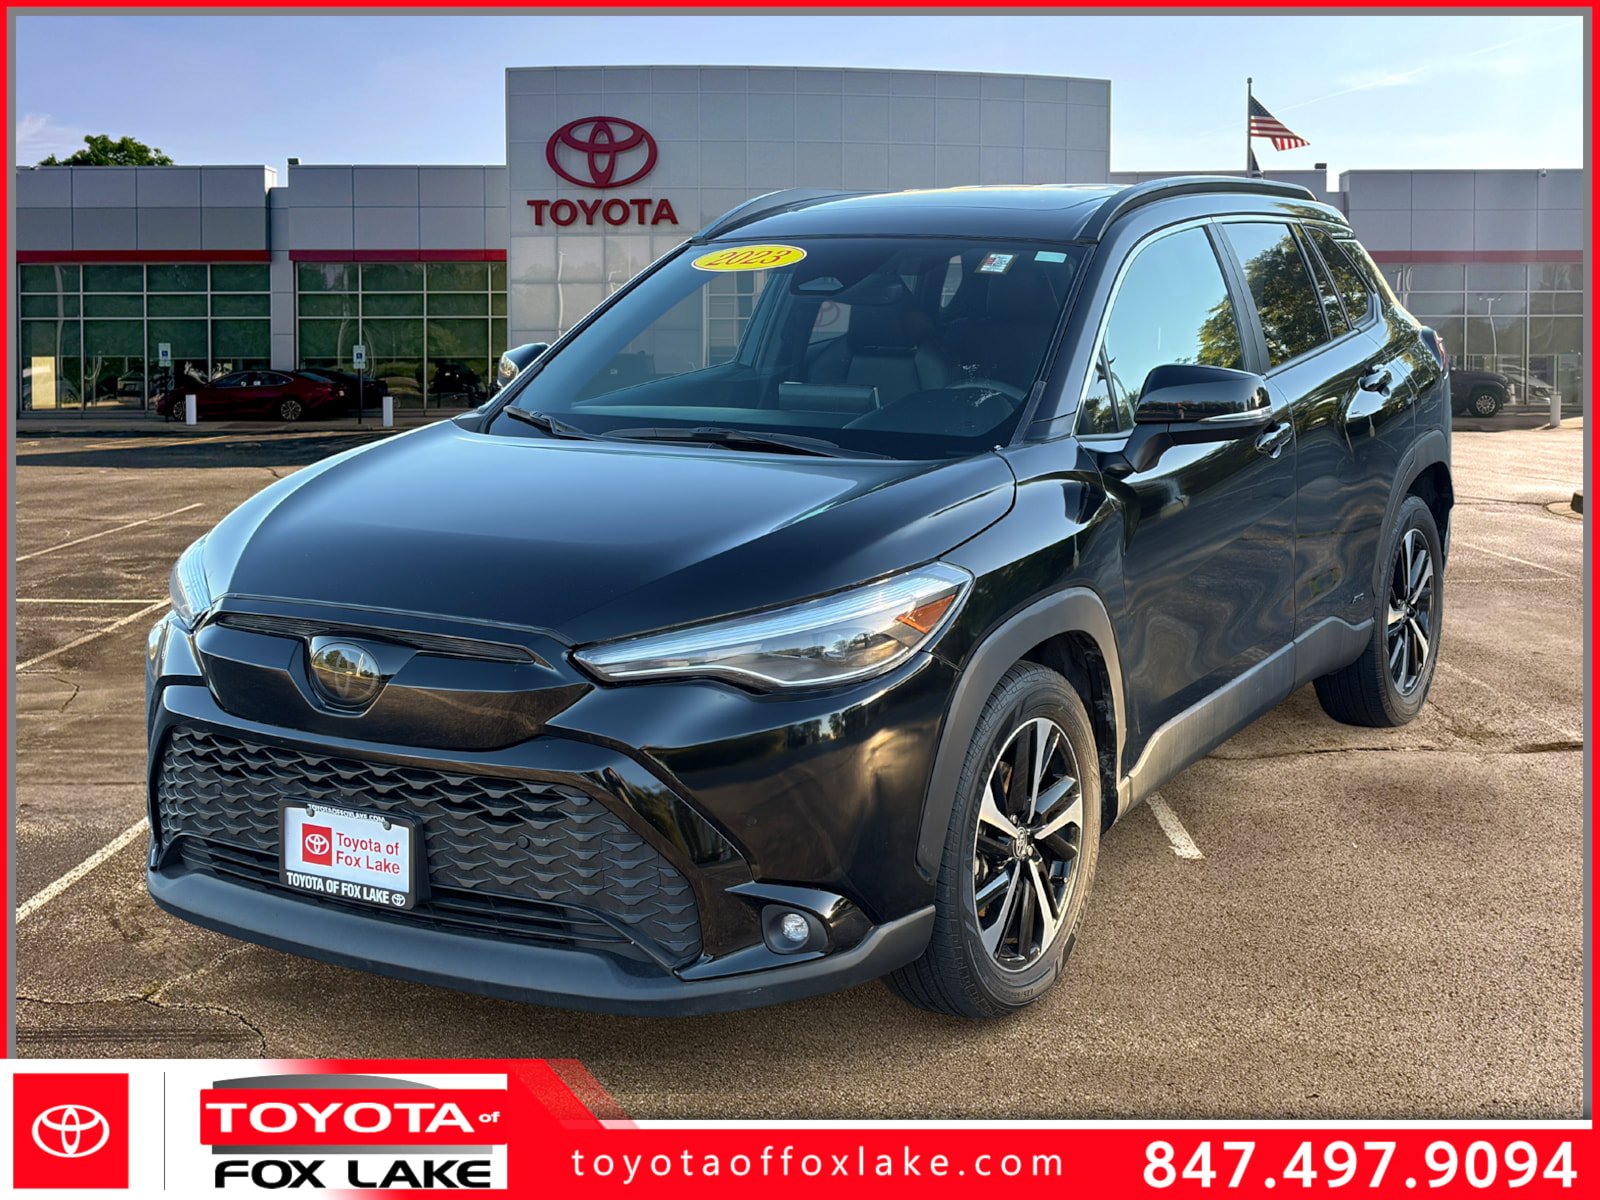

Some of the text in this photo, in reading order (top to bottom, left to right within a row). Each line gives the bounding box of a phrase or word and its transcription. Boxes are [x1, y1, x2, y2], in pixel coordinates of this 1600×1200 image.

[527, 198, 679, 226] TOYOTA
[705, 249, 792, 267] 2023
[336, 832, 400, 855] Toyota of
[336, 850, 400, 874] Fox Lake
[286, 872, 390, 905] TOYOTA OF FOX LAKE
